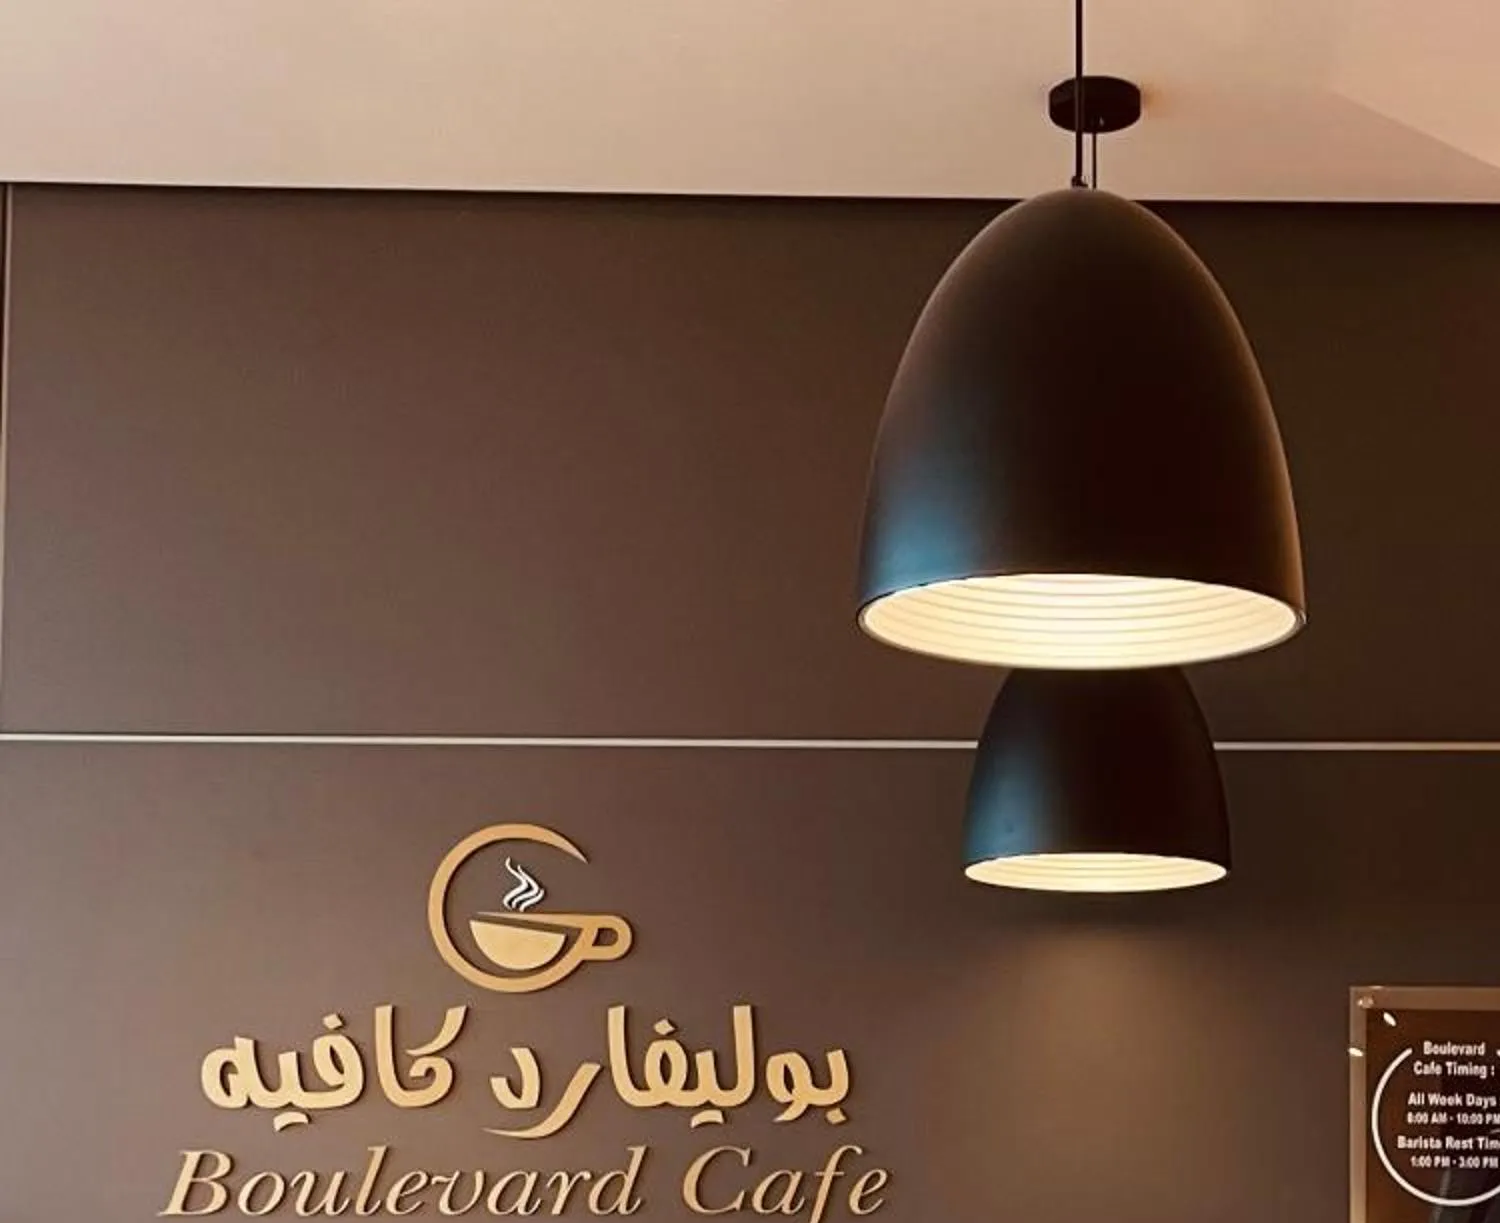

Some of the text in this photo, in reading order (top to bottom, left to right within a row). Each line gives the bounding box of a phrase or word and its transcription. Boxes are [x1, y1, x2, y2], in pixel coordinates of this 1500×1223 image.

[1423, 1041, 1486, 1056] Boulevard
[200, 1004, 850, 1138] بوليفارد كافيه
[1413, 1061, 1442, 1075] Cafe
[1445, 1061, 1487, 1079] Timing
[1407, 1091, 1425, 1106] All
[1427, 1091, 1463, 1106] Week
[1465, 1093, 1497, 1109] Days
[1431, 1112, 1448, 1124] AM
[1397, 1135, 1443, 1149] Barista
[1445, 1135, 1473, 1150] Rest
[1433, 1155, 1451, 1168] PM
[1482, 1156, 1499, 1169] PM
[157, 1145, 647, 1218] Boulevard
